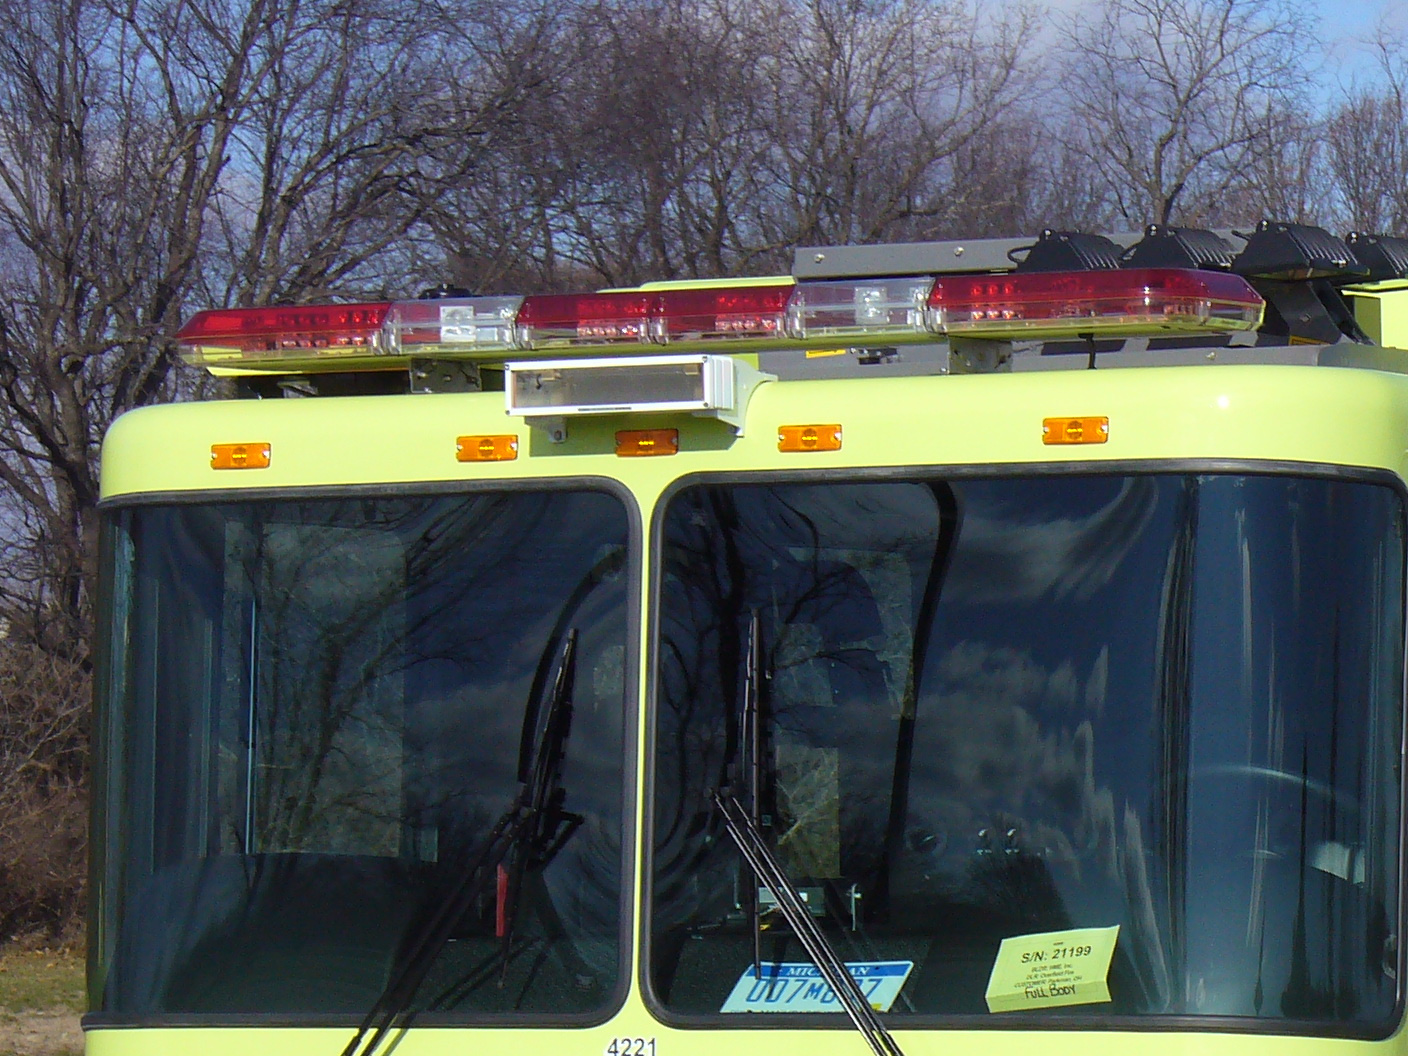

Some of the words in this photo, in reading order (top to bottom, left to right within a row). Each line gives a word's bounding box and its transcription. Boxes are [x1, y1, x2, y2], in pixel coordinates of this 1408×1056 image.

[1021, 951, 1047, 963] S/N:
[1052, 946, 1091, 959] 21199
[787, 966, 871, 977] MICAN
[745, 978, 883, 1004] 007M7
[1025, 986, 1049, 999] FULL
[1049, 983, 1076, 998] BODY
